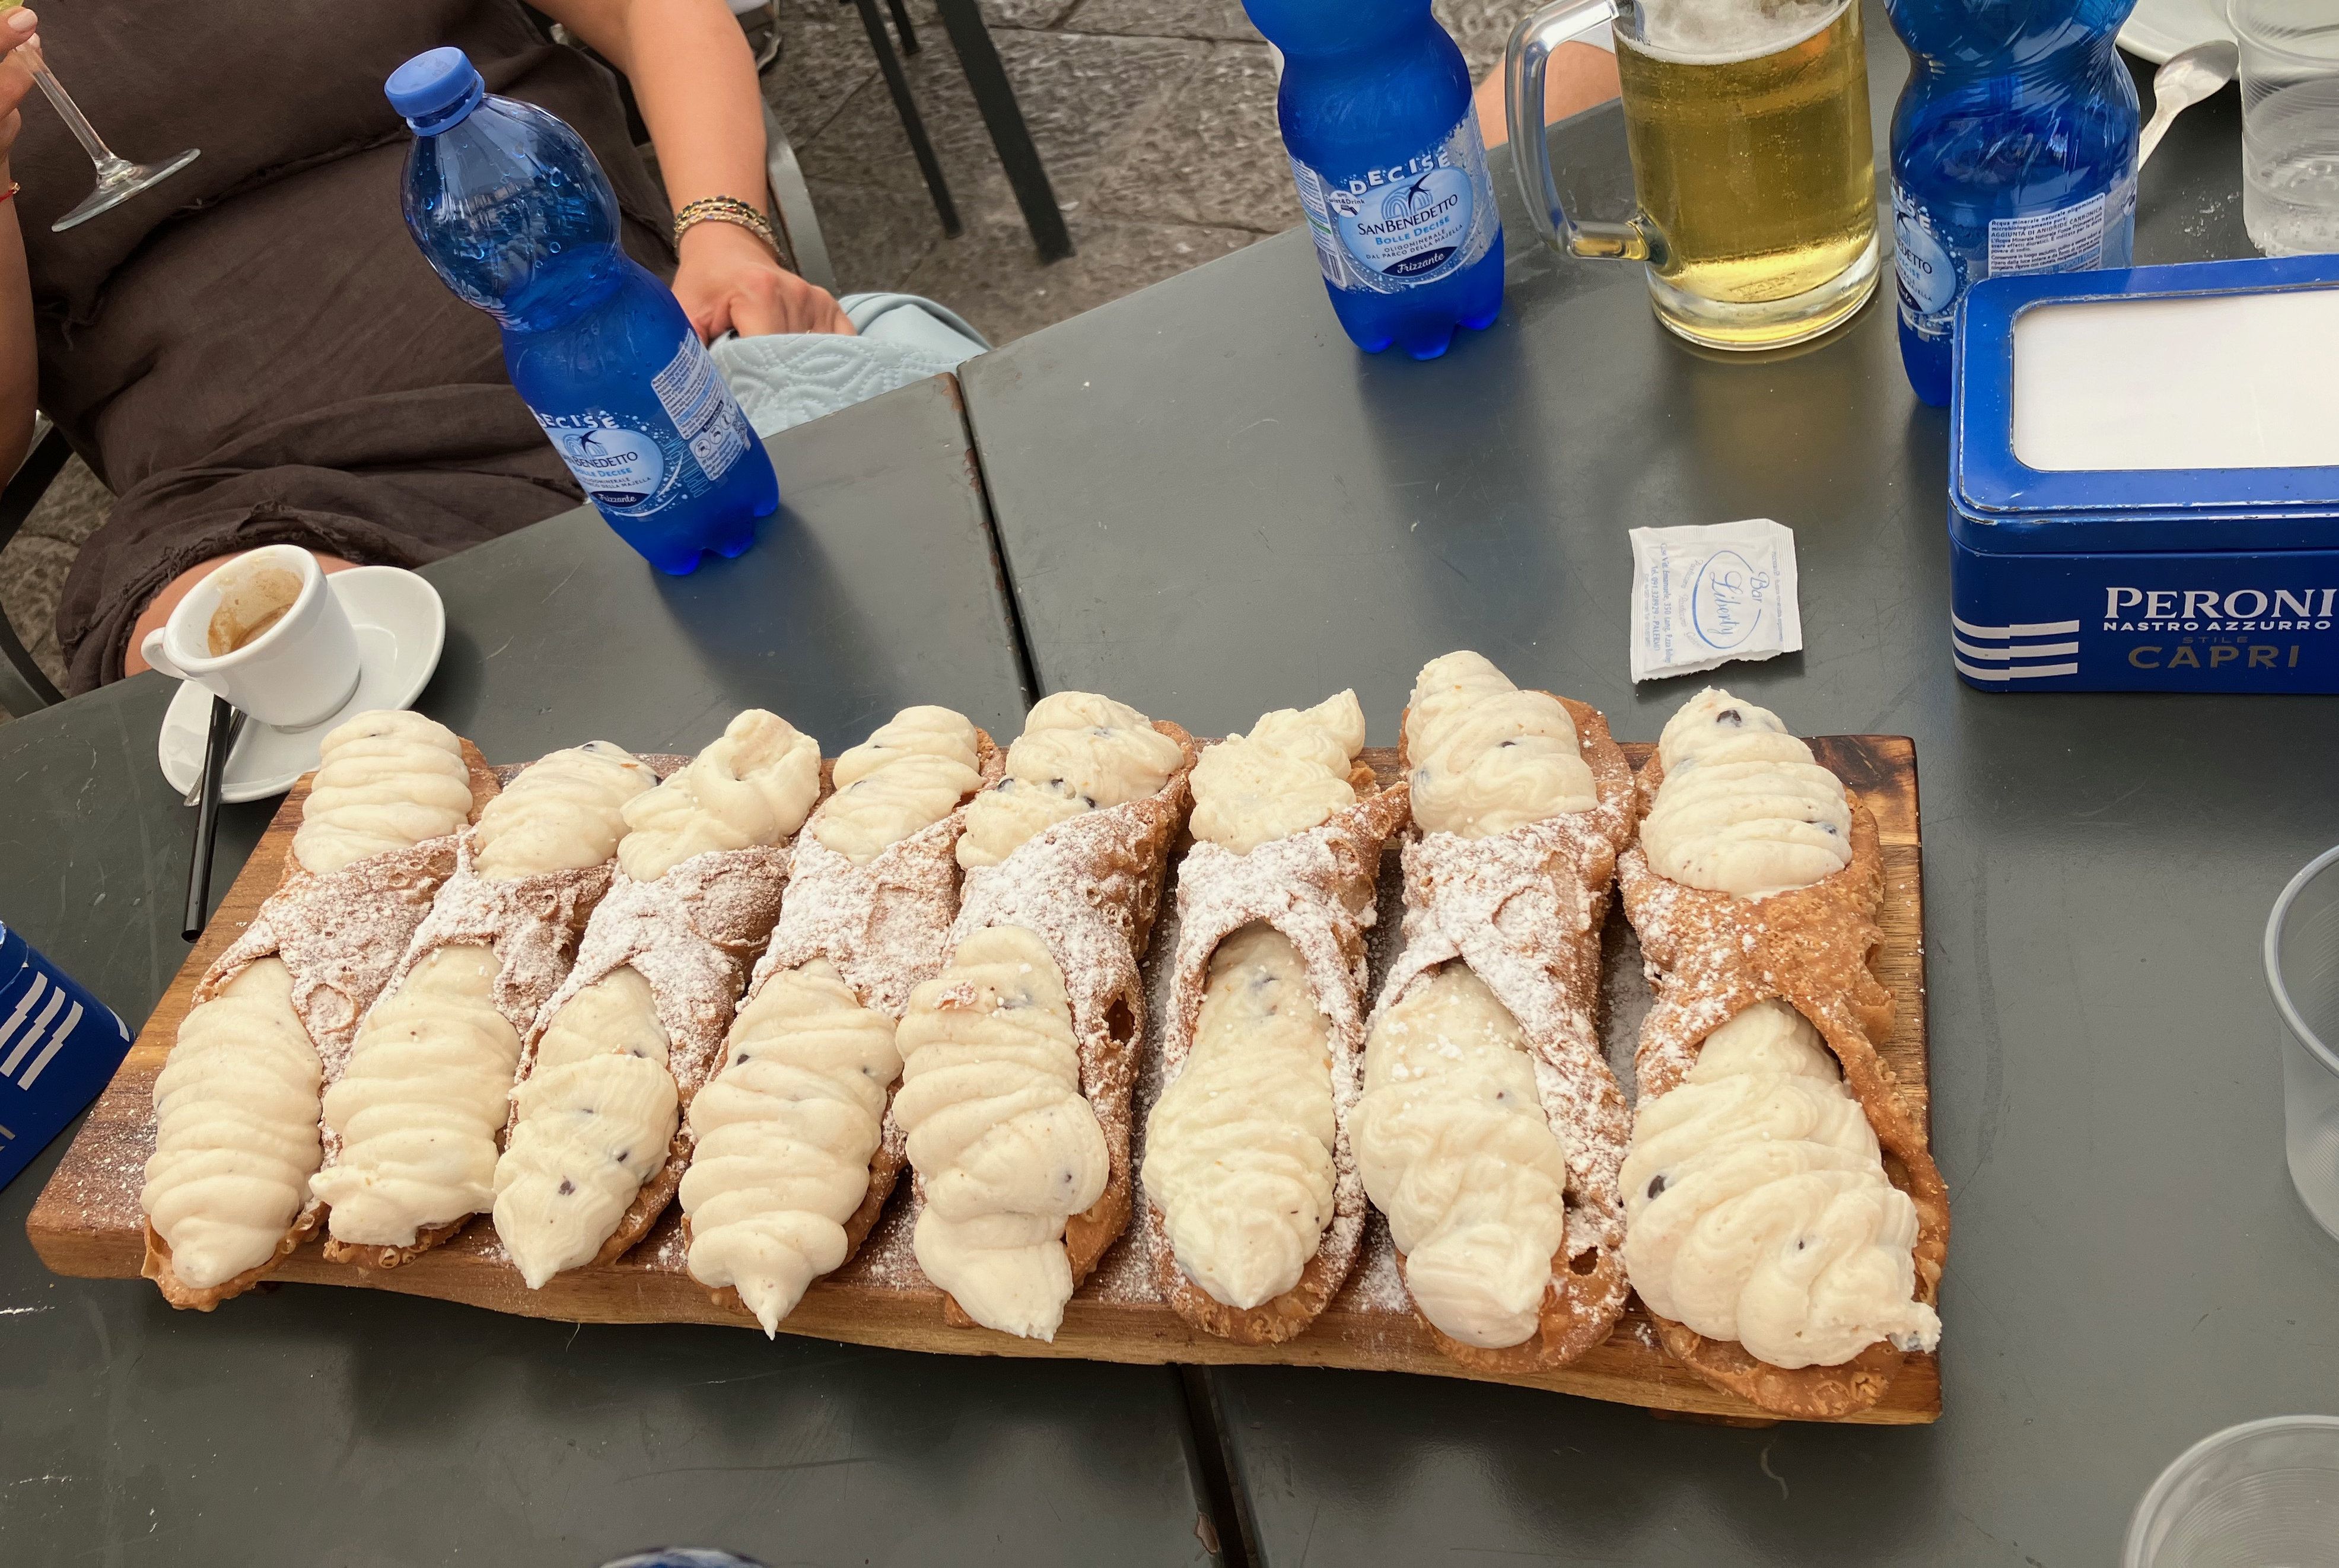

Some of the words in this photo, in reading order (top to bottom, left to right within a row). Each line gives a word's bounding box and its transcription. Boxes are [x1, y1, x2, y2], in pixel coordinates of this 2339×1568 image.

[1349, 151, 1451, 195] DECISE
[2012, 217, 2039, 225] minerale
[2041, 211, 2066, 221] naturale
[2067, 194, 2103, 214] oligominerale
[2036, 221, 2067, 234] ANIDRIDE
[2069, 205, 2102, 225] CARBONICA
[1375, 233, 1411, 246] BOLLE
[1414, 215, 1450, 237] DECISE
[1991, 222, 2052, 232] microbiologicamente
[1382, 249, 1408, 259] PARCO
[1410, 241, 1434, 253] DELLA
[1435, 224, 1463, 244] MAJELLA
[1384, 228, 1446, 253] OLIGOMINERALE
[1396, 252, 1445, 274] Frizzante
[598, 467, 633, 478] DECISE
[621, 476, 652, 487] MAJELLA
[597, 493, 637, 503] Frizzante
[1750, 571, 1770, 603] Bar
[1663, 602, 1672, 615] 350
[1707, 571, 1744, 635] Liberty
[2104, 587, 2338, 619] PERONI
[1653, 620, 1661, 651] PALERMO
[2103, 622, 2199, 631] NASTRO
[2206, 620, 2331, 631] AZZURRO
[2182, 635, 2249, 644] STILE
[2128, 645, 2300, 669] CAPRI
